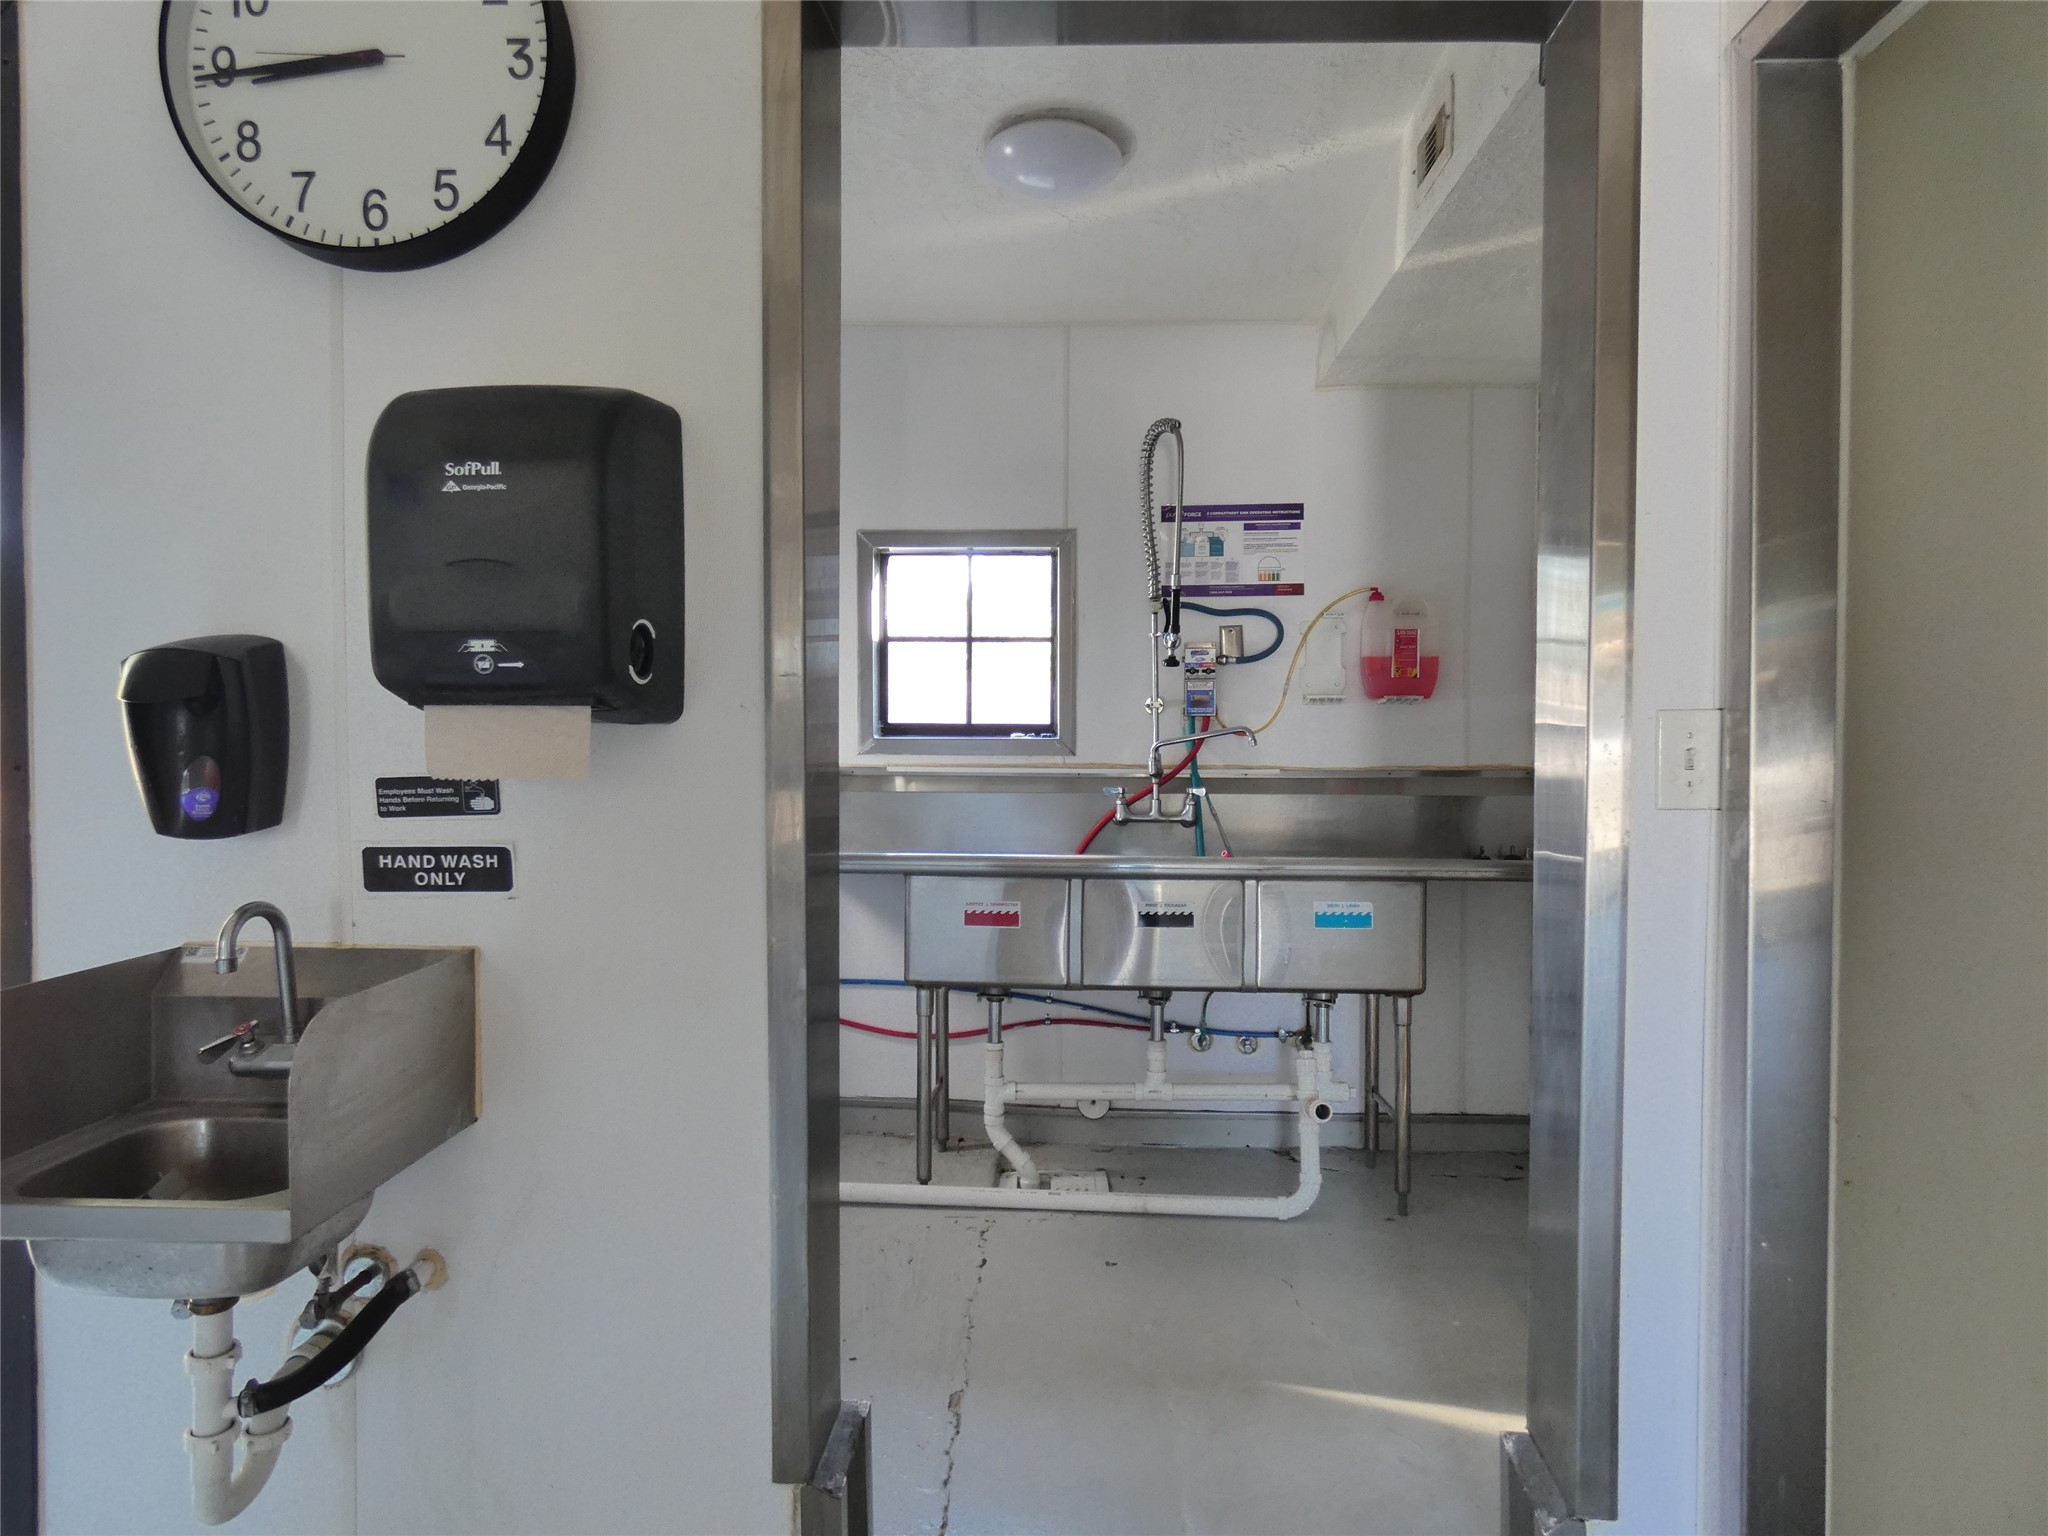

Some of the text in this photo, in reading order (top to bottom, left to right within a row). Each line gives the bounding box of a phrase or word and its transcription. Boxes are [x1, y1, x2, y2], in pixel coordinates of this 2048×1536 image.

[212, 46, 236, 88] 9
[506, 38, 534, 80] 3
[236, 120, 262, 162] 8
[485, 114, 512, 156] 4
[291, 171, 316, 213] 7
[363, 189, 389, 231] 6
[434, 169, 460, 211] 5
[378, 788, 416, 796] Employees
[426, 796, 460, 804] Returning
[379, 854, 498, 869] HAND WASH
[414, 872, 466, 886] ONLY
